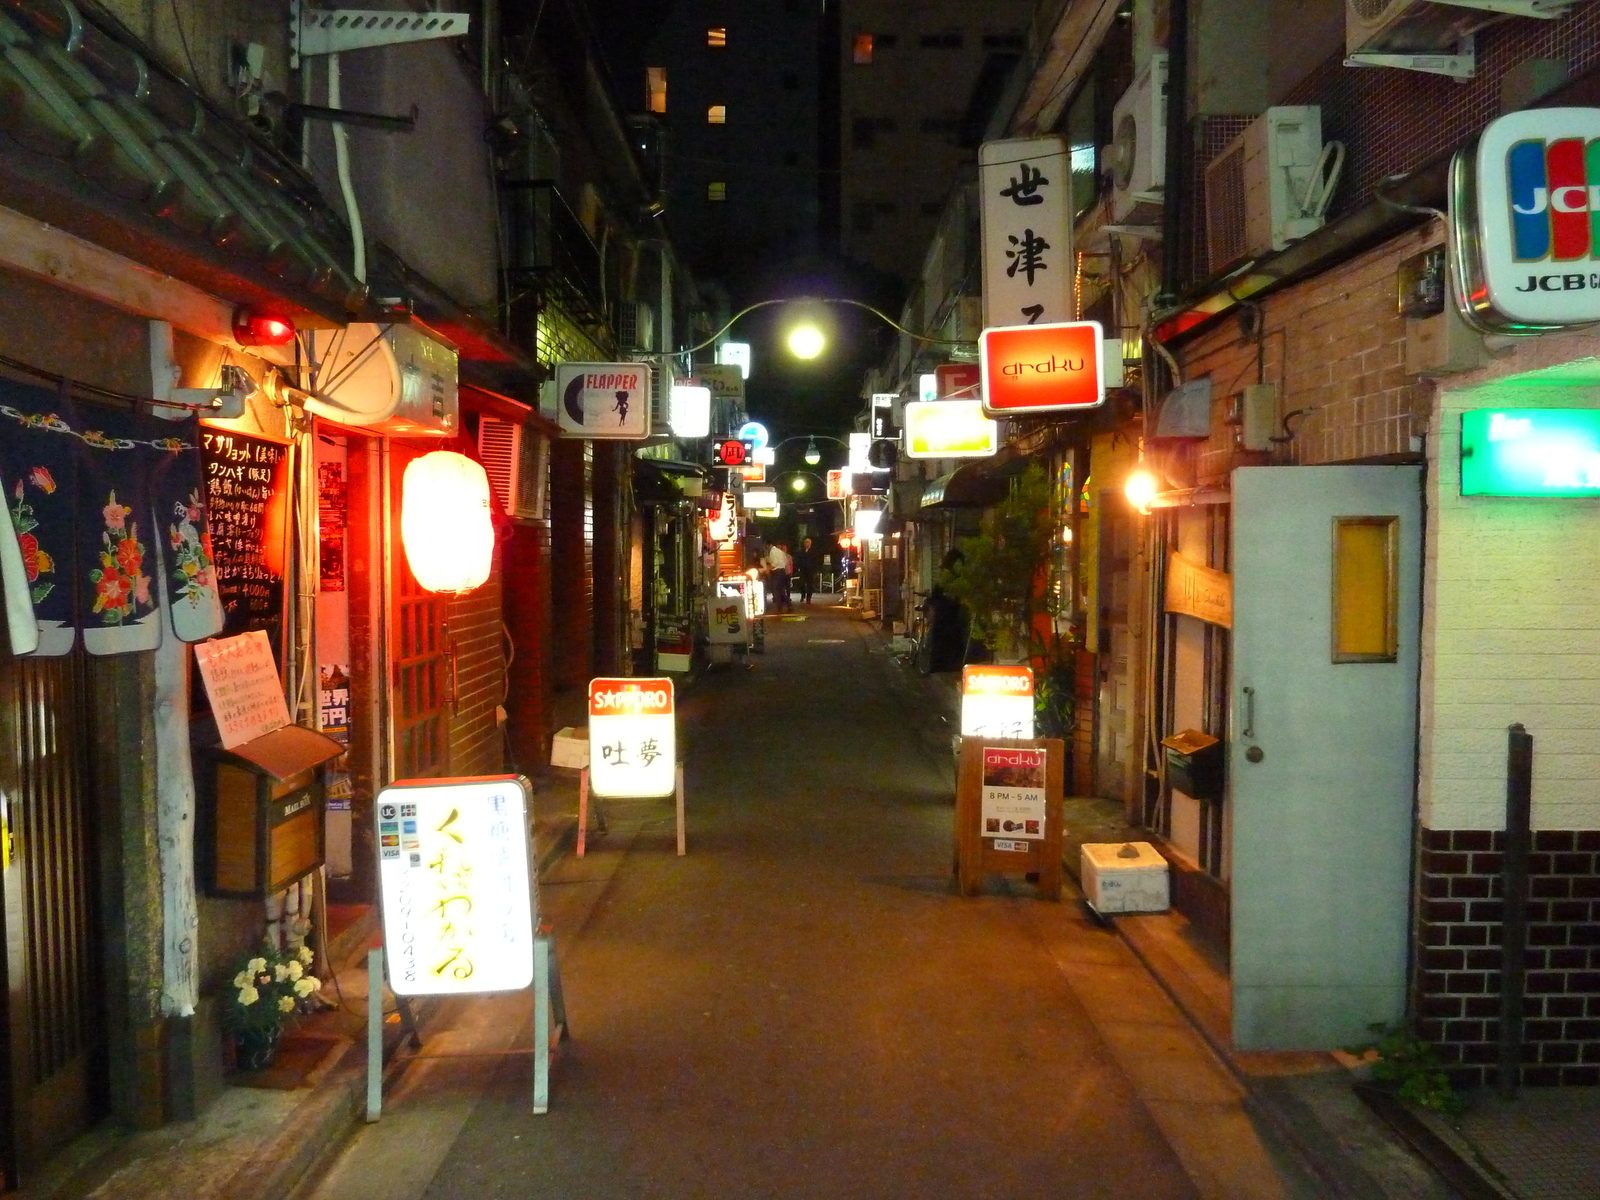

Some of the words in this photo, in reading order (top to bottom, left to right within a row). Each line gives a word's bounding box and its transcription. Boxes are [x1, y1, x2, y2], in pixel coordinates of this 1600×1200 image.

[1513, 185, 1600, 215] JC
[1515, 273, 1586, 292] JCB
[1002, 354, 1085, 376] araku
[586, 374, 638, 390] FLAPPER
[601, 737, 663, 768] 吐夢
[987, 752, 1041, 766] araku
[989, 792, 995, 800] 8
[997, 792, 1010, 800] PM
[1017, 793, 1022, 801] 5
[382, 807, 397, 818] UC
[383, 850, 400, 858] VISA
